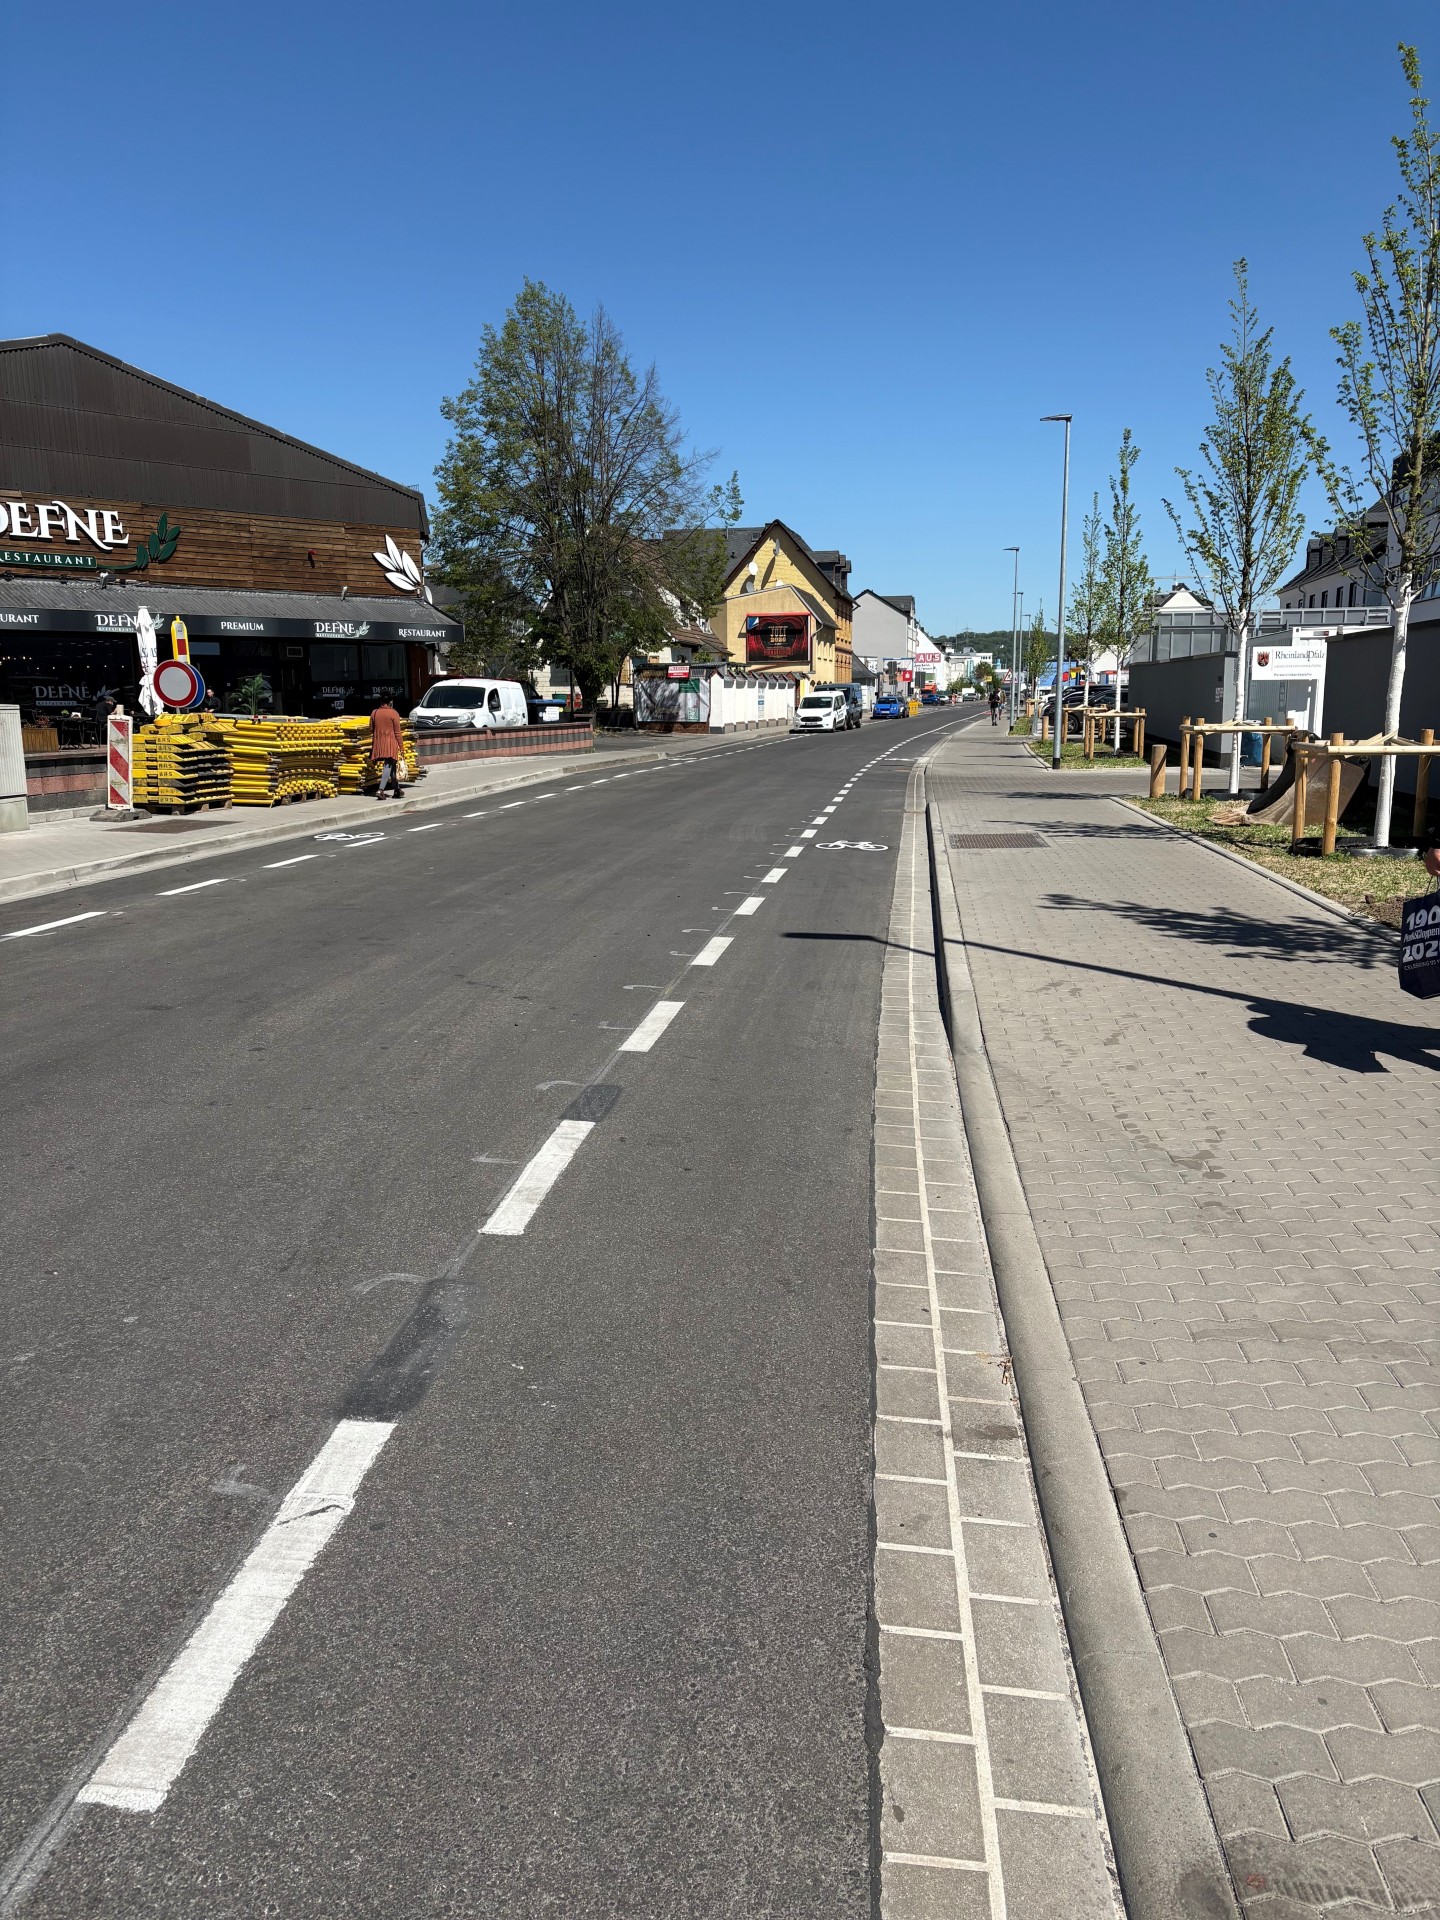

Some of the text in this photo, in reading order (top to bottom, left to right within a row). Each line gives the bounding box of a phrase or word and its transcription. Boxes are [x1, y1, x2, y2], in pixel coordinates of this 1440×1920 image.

[0, 551, 94, 567] ESTAURANT
[94, 613, 138, 630] DEFN
[220, 621, 264, 631] PREMIUM
[314, 621, 356, 636] DEFNE
[398, 628, 447, 638] RESTAURANT
[32, 684, 92, 701] DEFNE
[1402, 940, 1440, 964] 202
